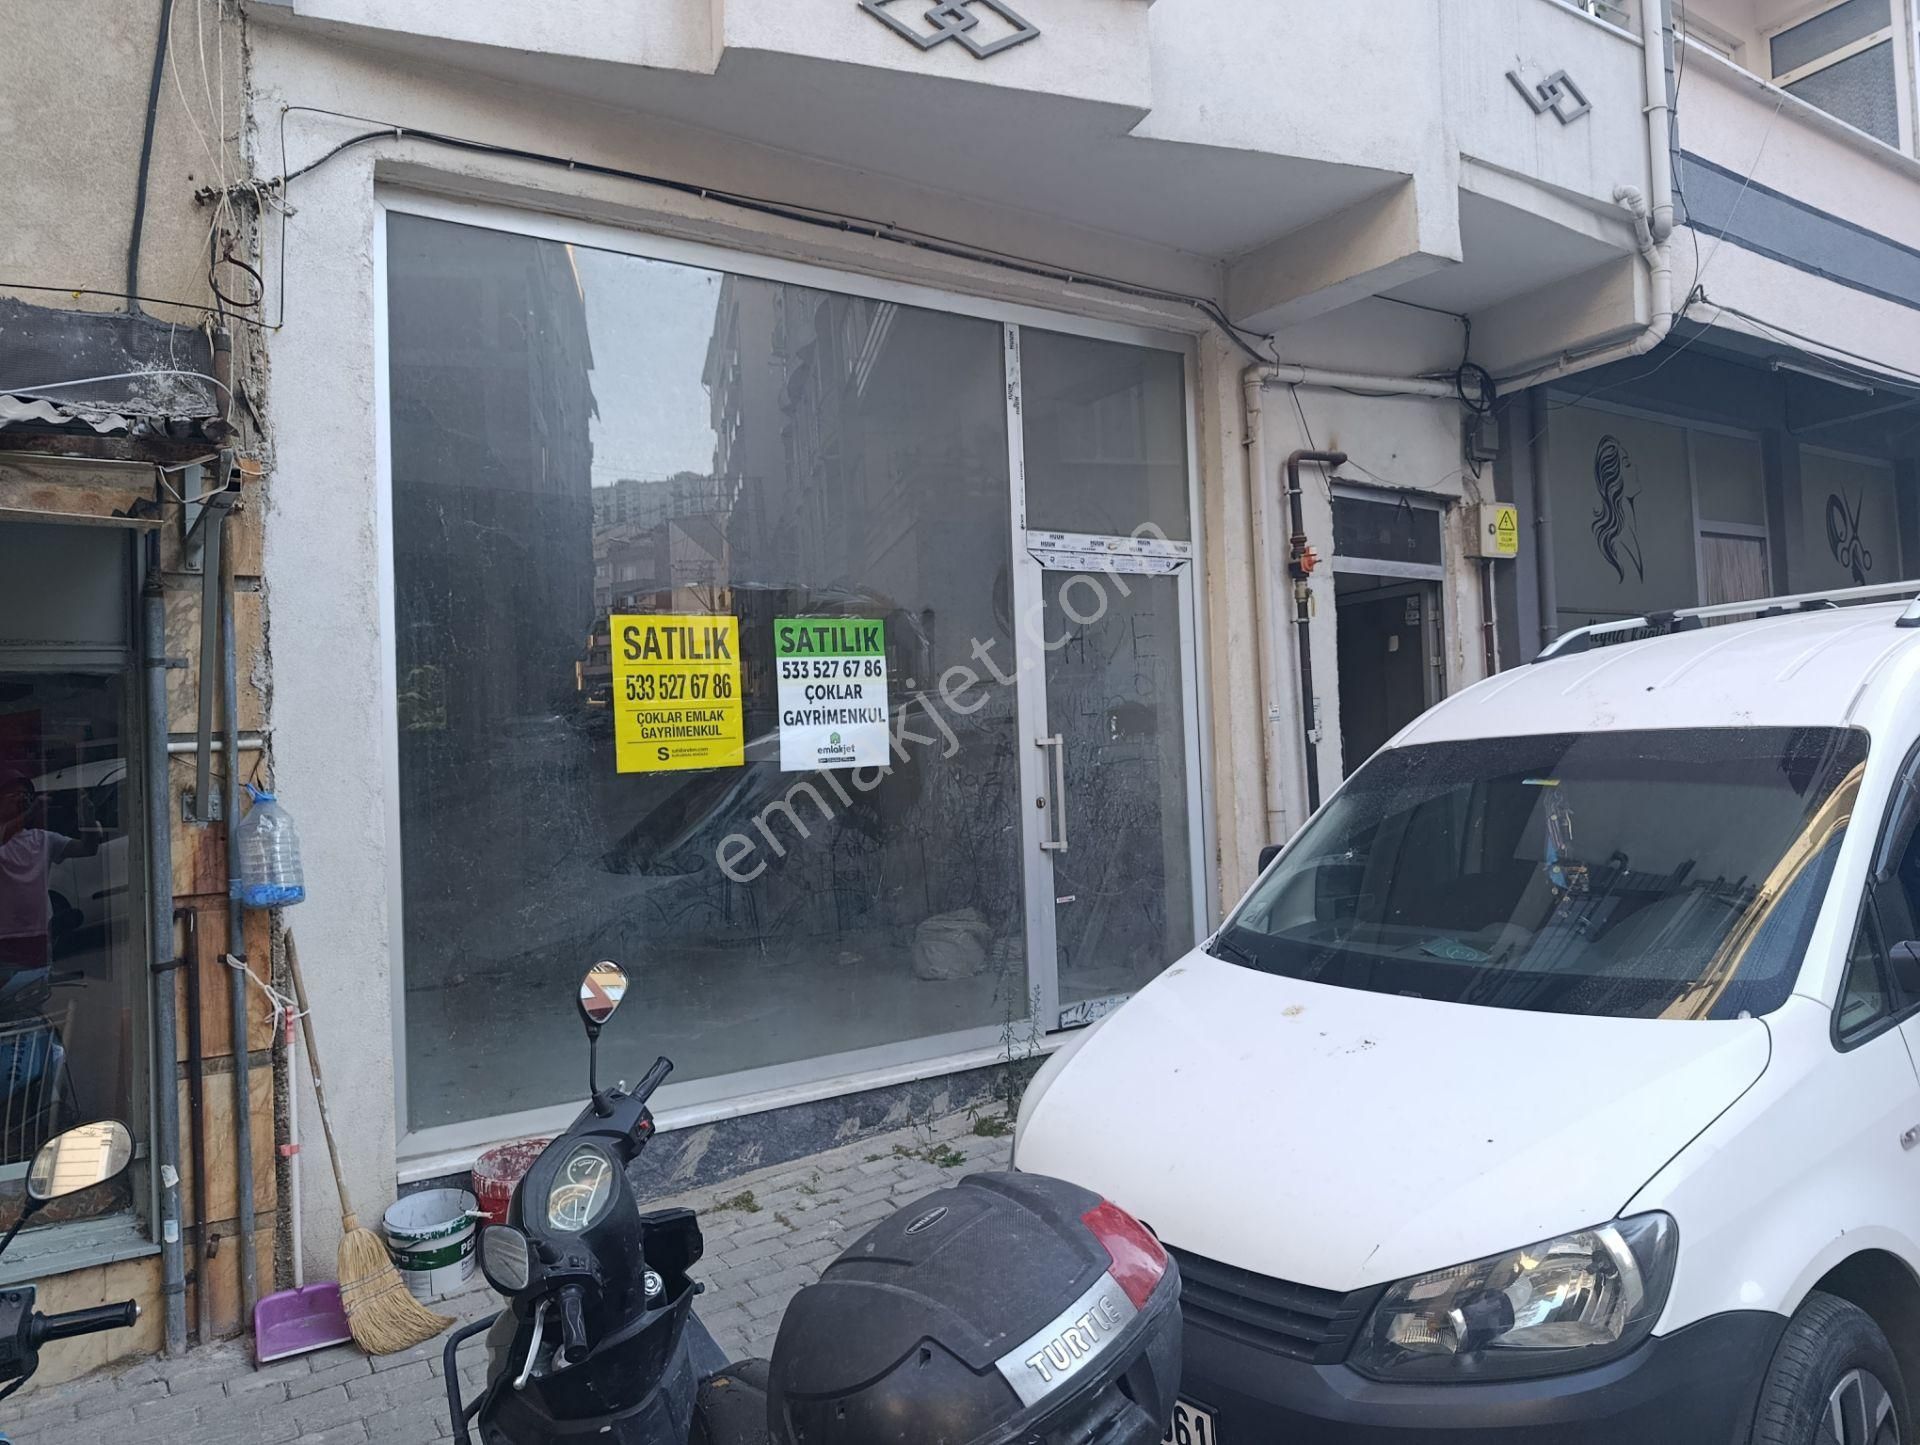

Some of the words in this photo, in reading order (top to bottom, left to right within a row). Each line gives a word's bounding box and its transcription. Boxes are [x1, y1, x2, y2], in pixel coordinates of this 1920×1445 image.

[623, 626, 731, 660] SATILIK
[780, 627, 880, 653] SATILIK
[782, 661, 809, 679] 533
[813, 660, 839, 678] 527
[843, 660, 860, 677] 67
[864, 660, 882, 677] 86
[626, 674, 655, 700] 533
[659, 674, 686, 699] 527
[690, 674, 709, 699] 67
[713, 673, 732, 699] 86
[805, 684, 863, 704] ÇOKLAR
[637, 711, 682, 727] ÇOKLAR
[685, 710, 725, 723] EMLAK
[783, 706, 886, 726] GAYRİMENKUL
[641, 724, 722, 739] GAYRİMENKUL
[817, 744, 855, 755] emlakjet
[1025, 1295, 1121, 1382] TURTLE
[1163, 1405, 1207, 1445] 61
